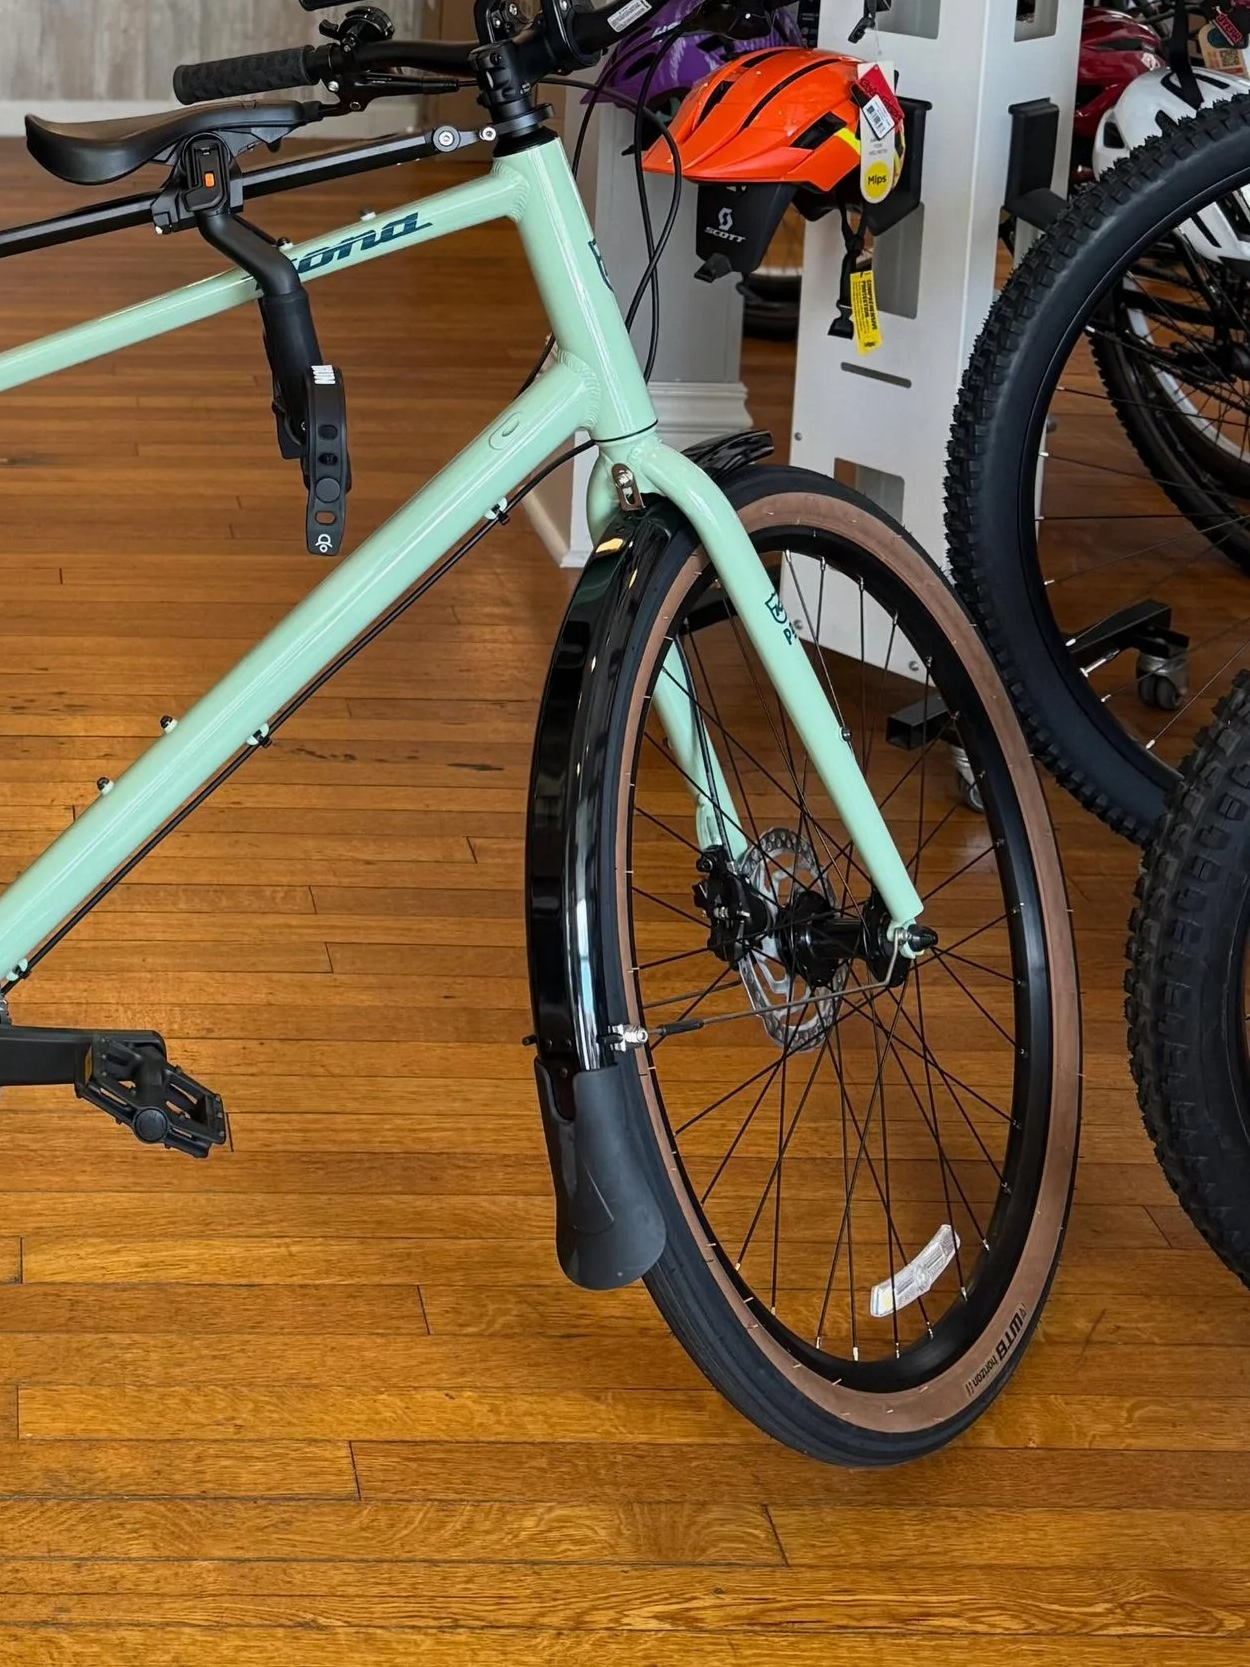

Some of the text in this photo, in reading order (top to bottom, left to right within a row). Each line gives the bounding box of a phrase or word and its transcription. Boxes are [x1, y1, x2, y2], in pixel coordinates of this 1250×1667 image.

[867, 174, 887, 185] Mips
[295, 210, 434, 274] ona
[704, 226, 746, 243] SCOTT
[972, 1312, 1024, 1387] WTB horizon
